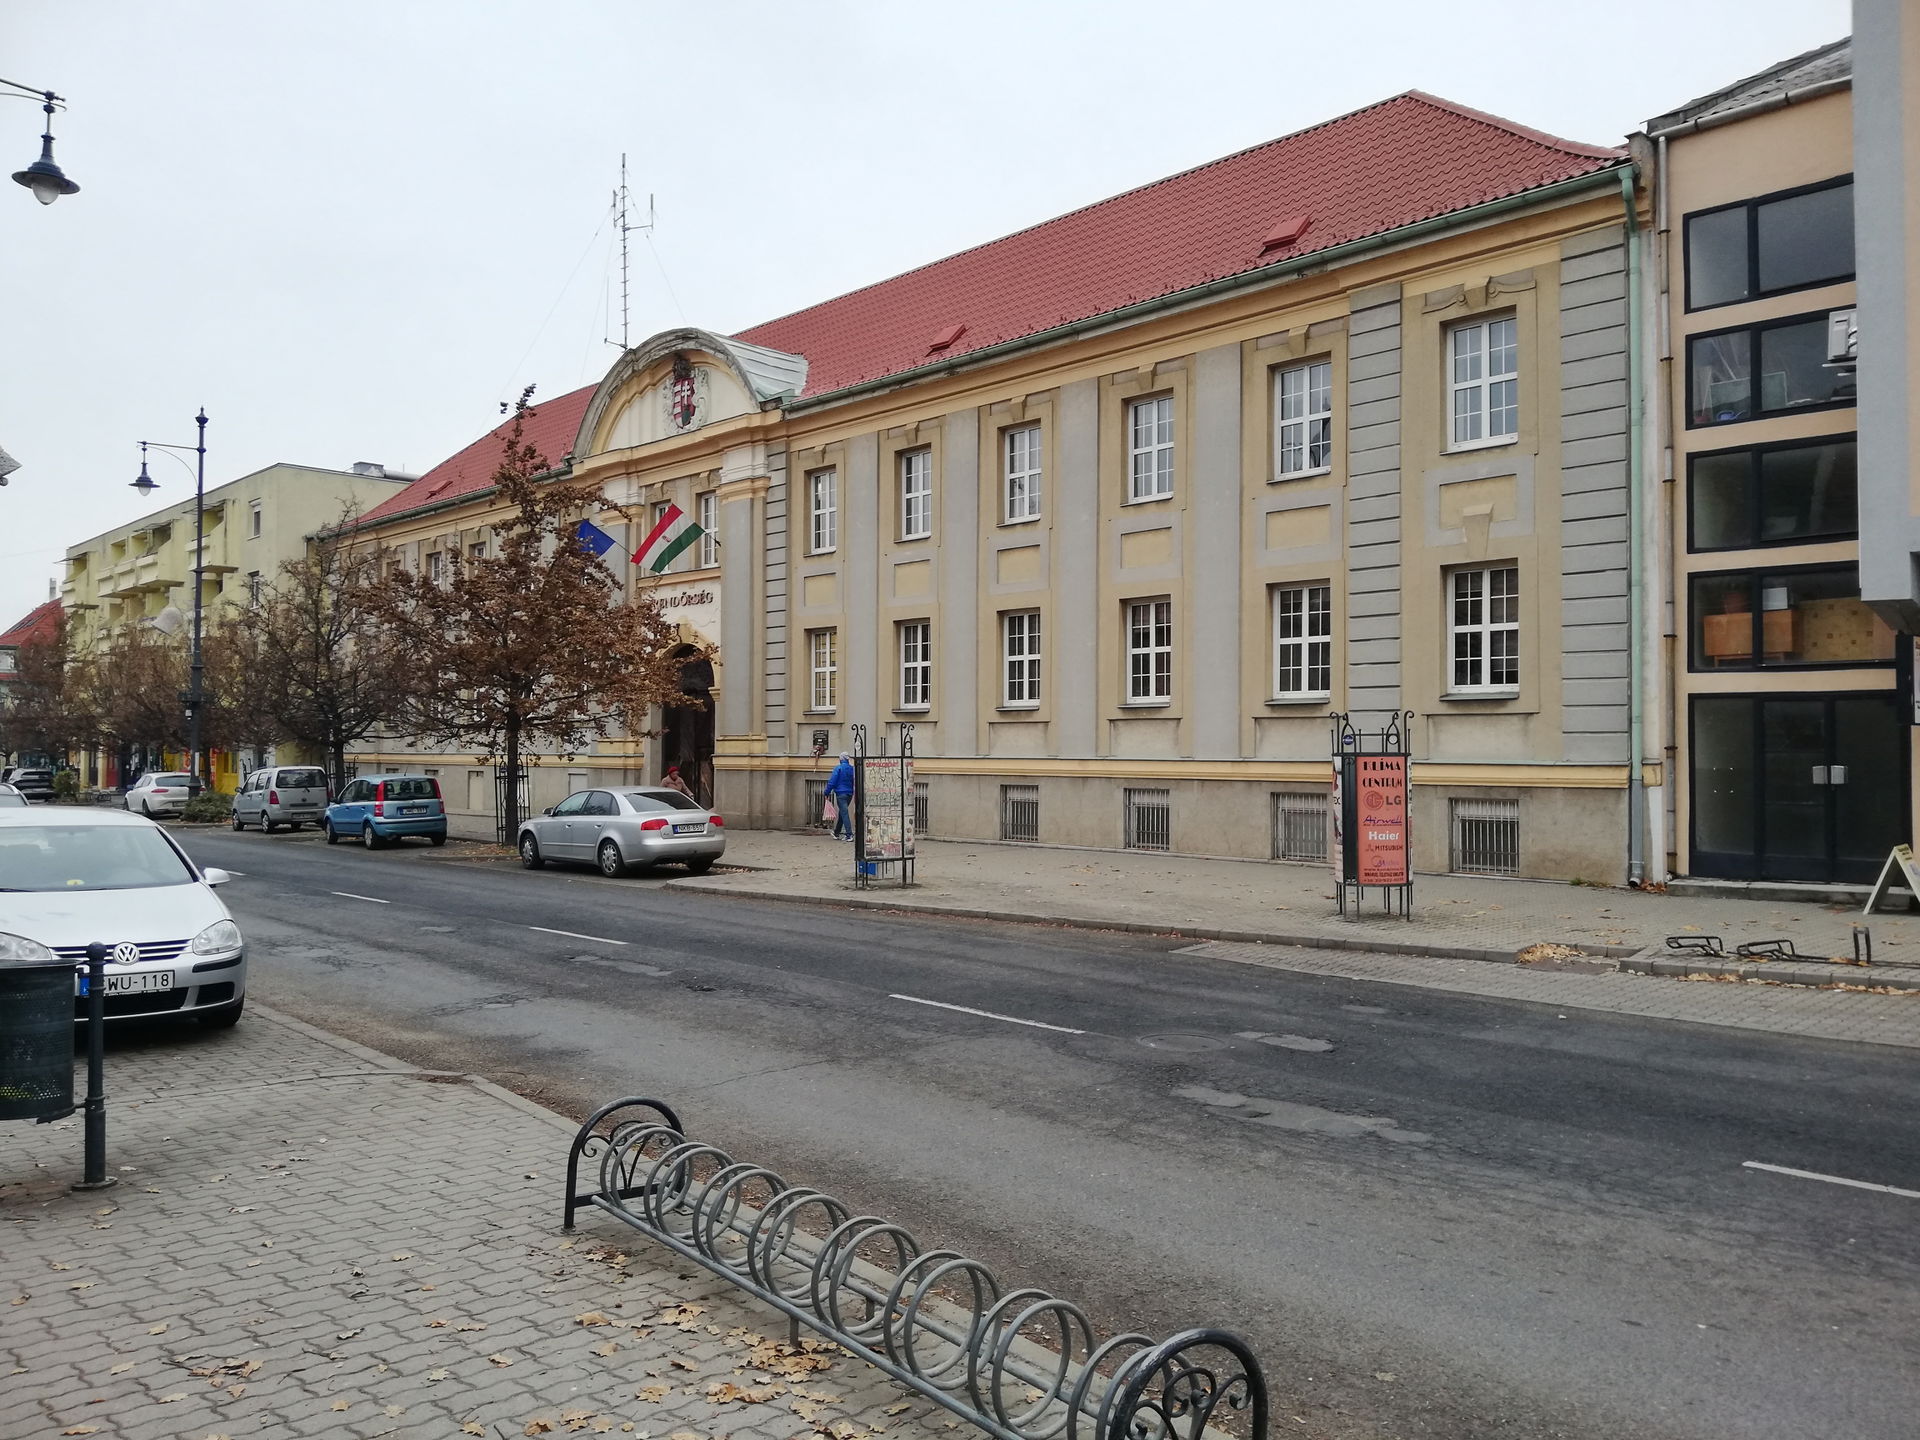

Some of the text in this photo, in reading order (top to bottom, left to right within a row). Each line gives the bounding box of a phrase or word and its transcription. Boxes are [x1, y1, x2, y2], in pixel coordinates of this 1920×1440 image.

[1363, 758, 1401, 770] KLÍMA
[1386, 795, 1402, 805] LG
[1368, 830, 1400, 840] Haier
[107, 973, 169, 991] WU-118
